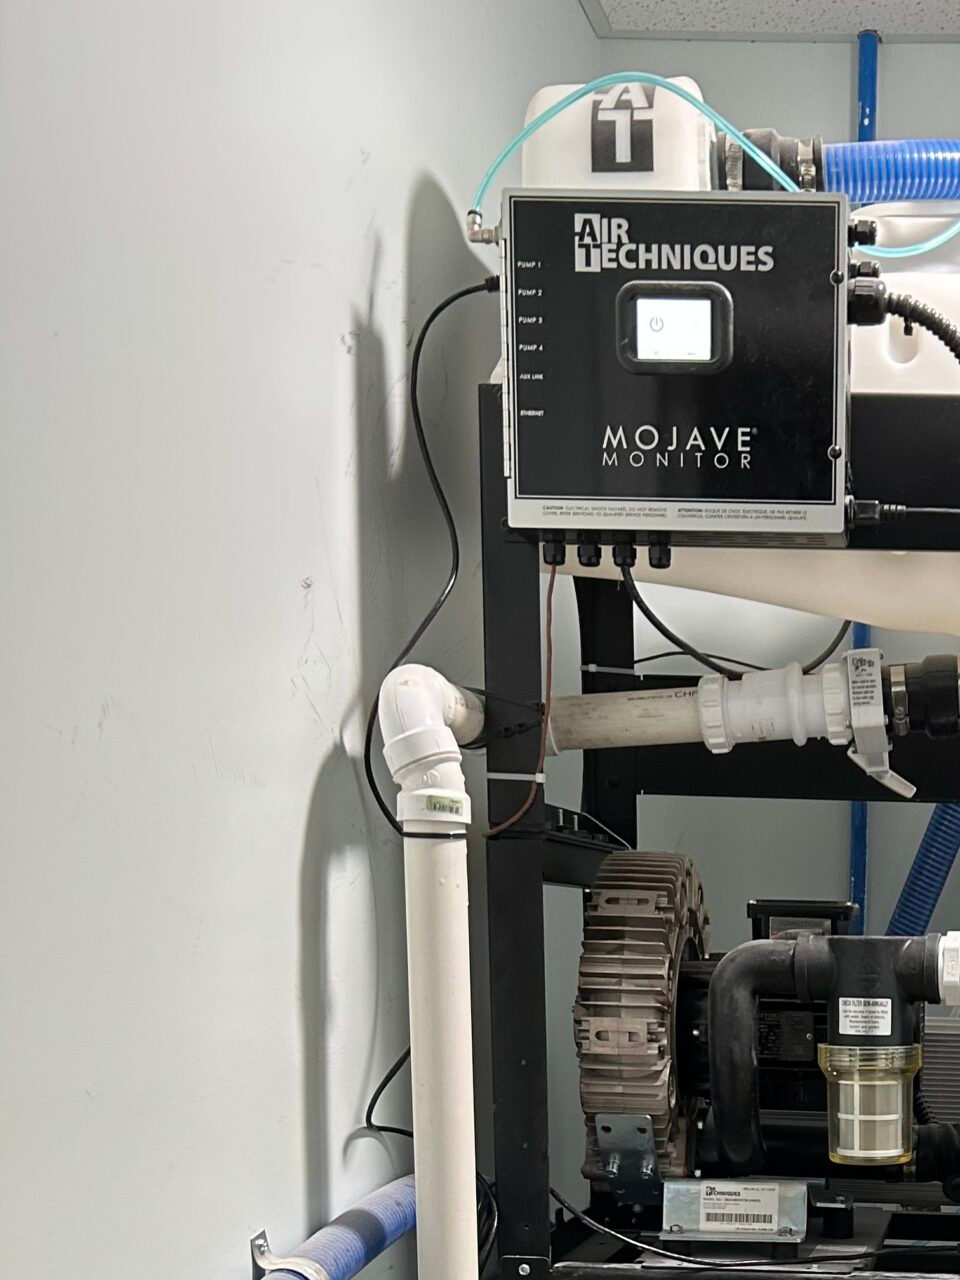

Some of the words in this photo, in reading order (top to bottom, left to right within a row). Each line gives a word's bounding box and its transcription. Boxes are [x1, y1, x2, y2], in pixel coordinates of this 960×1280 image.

[574, 213, 629, 244] AIR
[574, 240, 775, 273] TECHNIQUES
[602, 451, 750, 469] MONITOR
